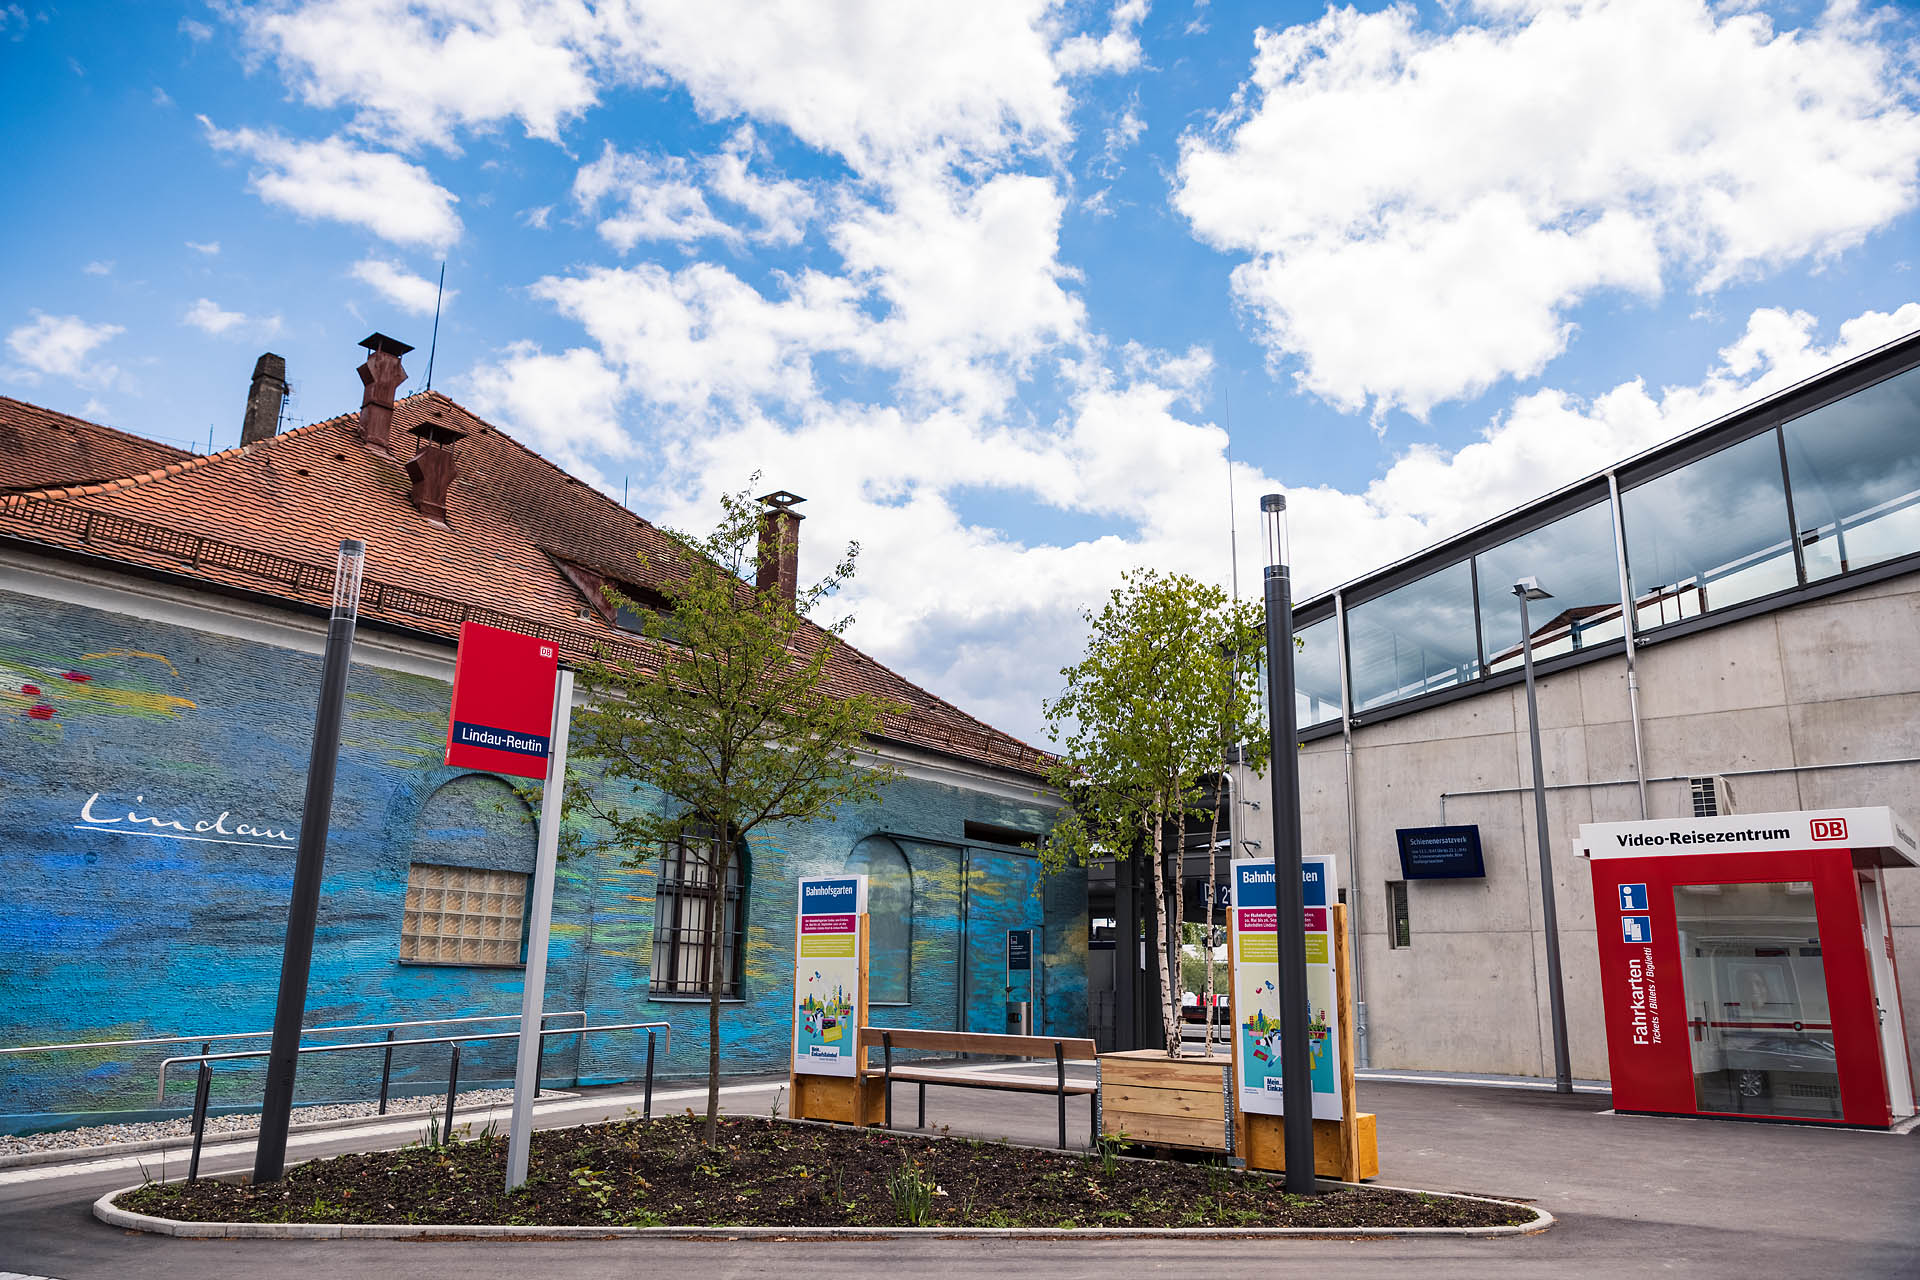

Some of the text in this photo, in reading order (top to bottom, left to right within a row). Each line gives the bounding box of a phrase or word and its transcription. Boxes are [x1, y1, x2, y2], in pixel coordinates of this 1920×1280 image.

[462, 727, 542, 752] Lindau-Reutin
[80, 792, 295, 841] Lindau
[1616, 826, 1791, 847] Video-Reisezentrum
[805, 885, 853, 898] Bahnhofsgarten
[1643, 947, 1655, 977] Biglietti
[1628, 959, 1649, 1045] Fahrkarten
[1648, 983, 1658, 1010] Billets
[1652, 1015, 1661, 1044] Tickets
